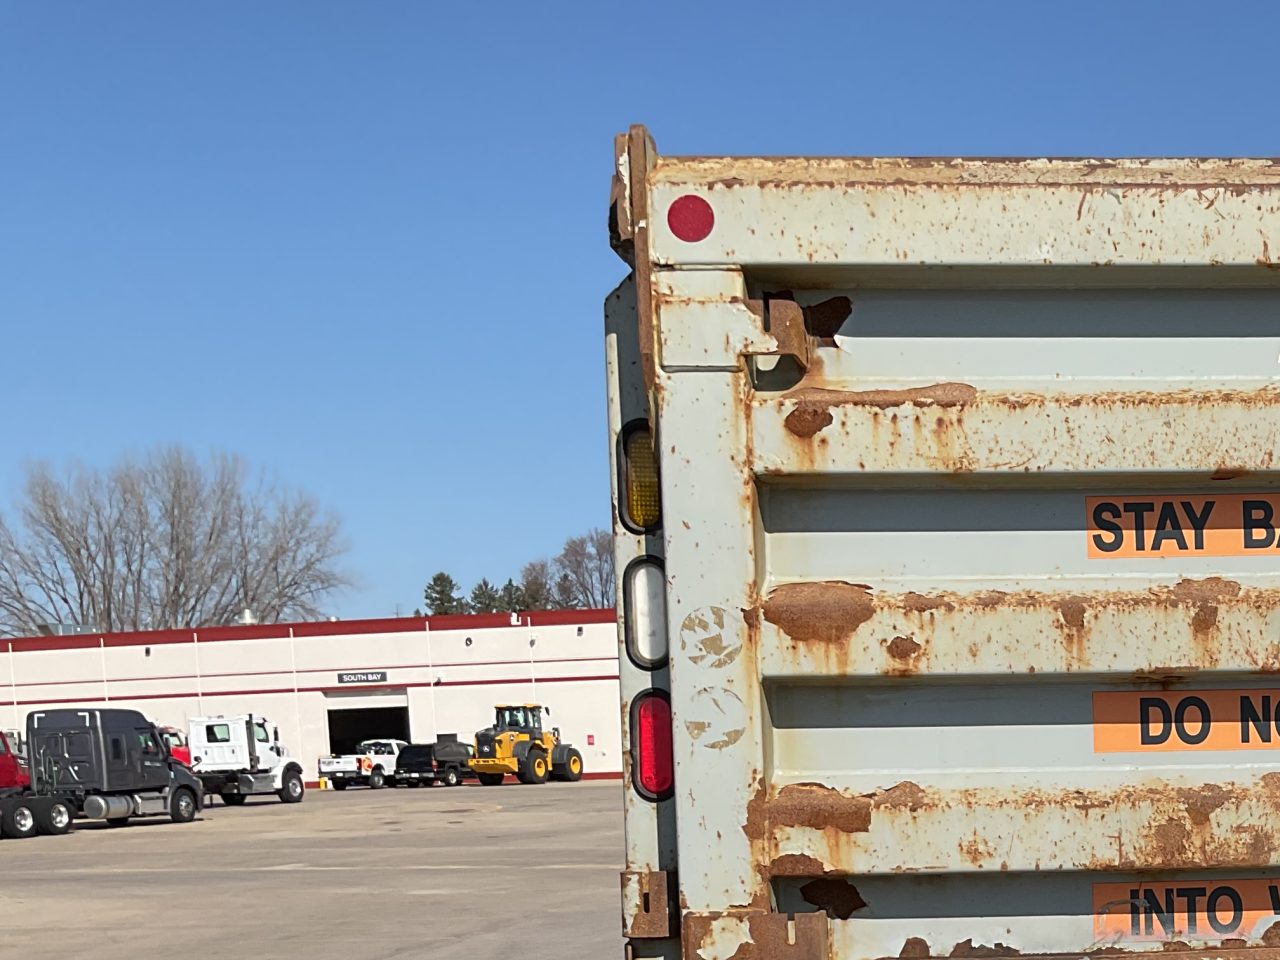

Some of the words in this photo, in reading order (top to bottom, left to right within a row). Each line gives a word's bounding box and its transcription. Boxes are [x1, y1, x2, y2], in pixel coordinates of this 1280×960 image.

[1093, 500, 1215, 551] STAY
[1140, 696, 1211, 745] DO
[1129, 885, 1243, 935] INTO
